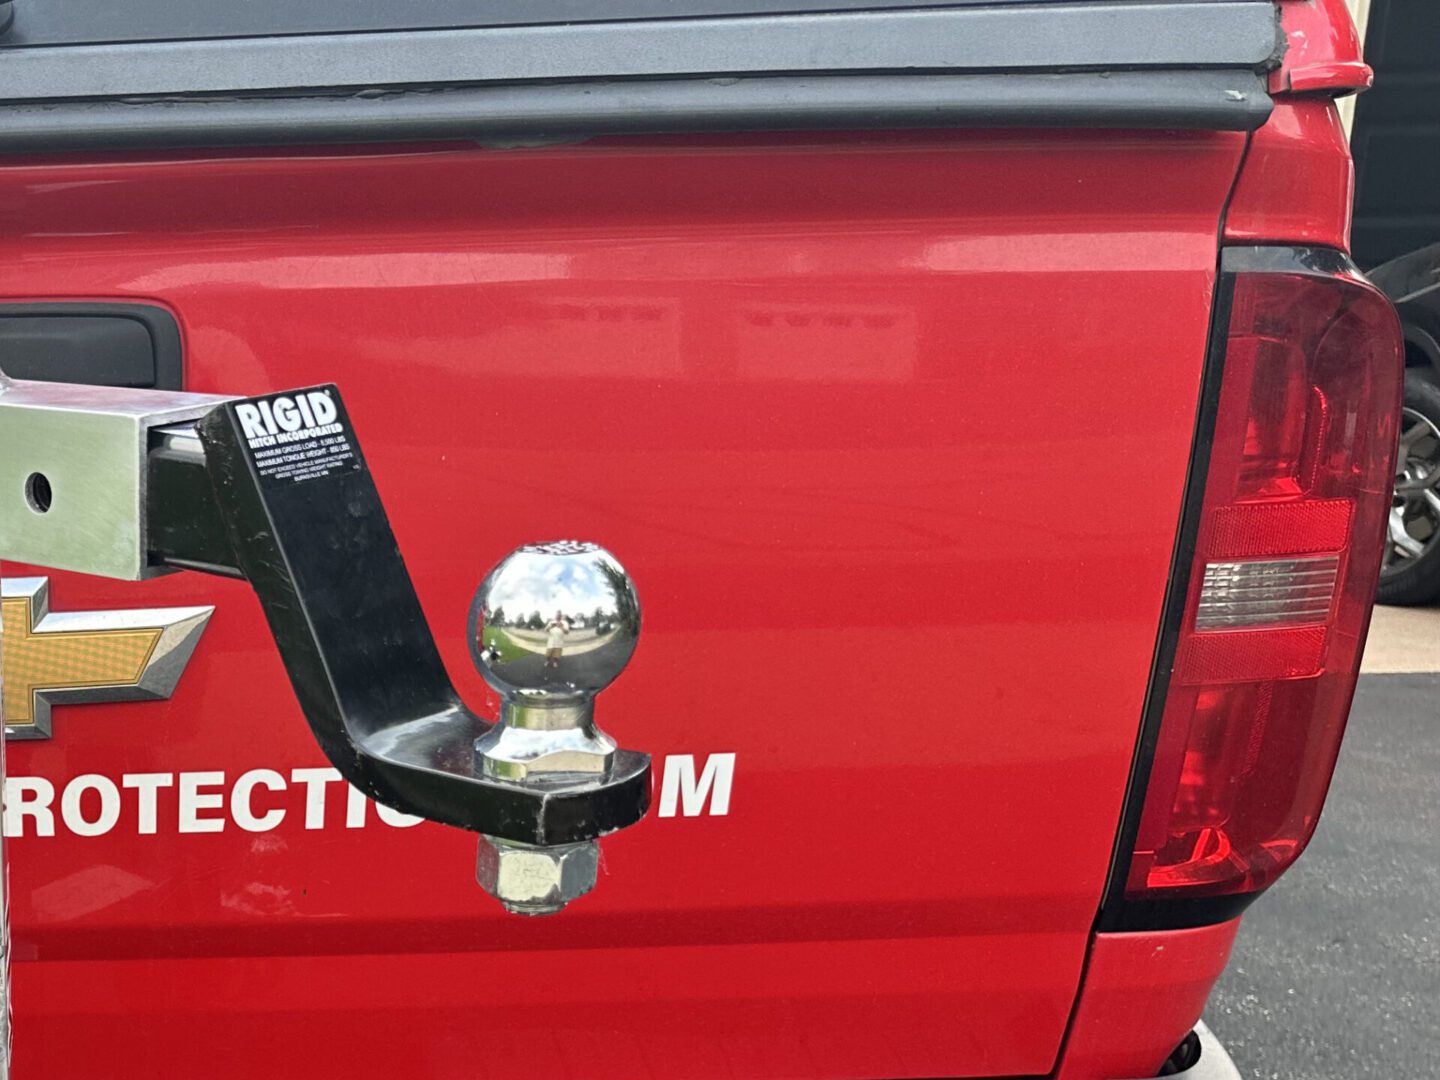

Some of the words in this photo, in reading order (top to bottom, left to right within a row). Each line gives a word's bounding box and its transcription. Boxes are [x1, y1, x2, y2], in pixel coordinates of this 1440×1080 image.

[235, 391, 337, 439] RIGID
[249, 436, 276, 449] HITCH
[276, 423, 343, 444] INCORPORATED
